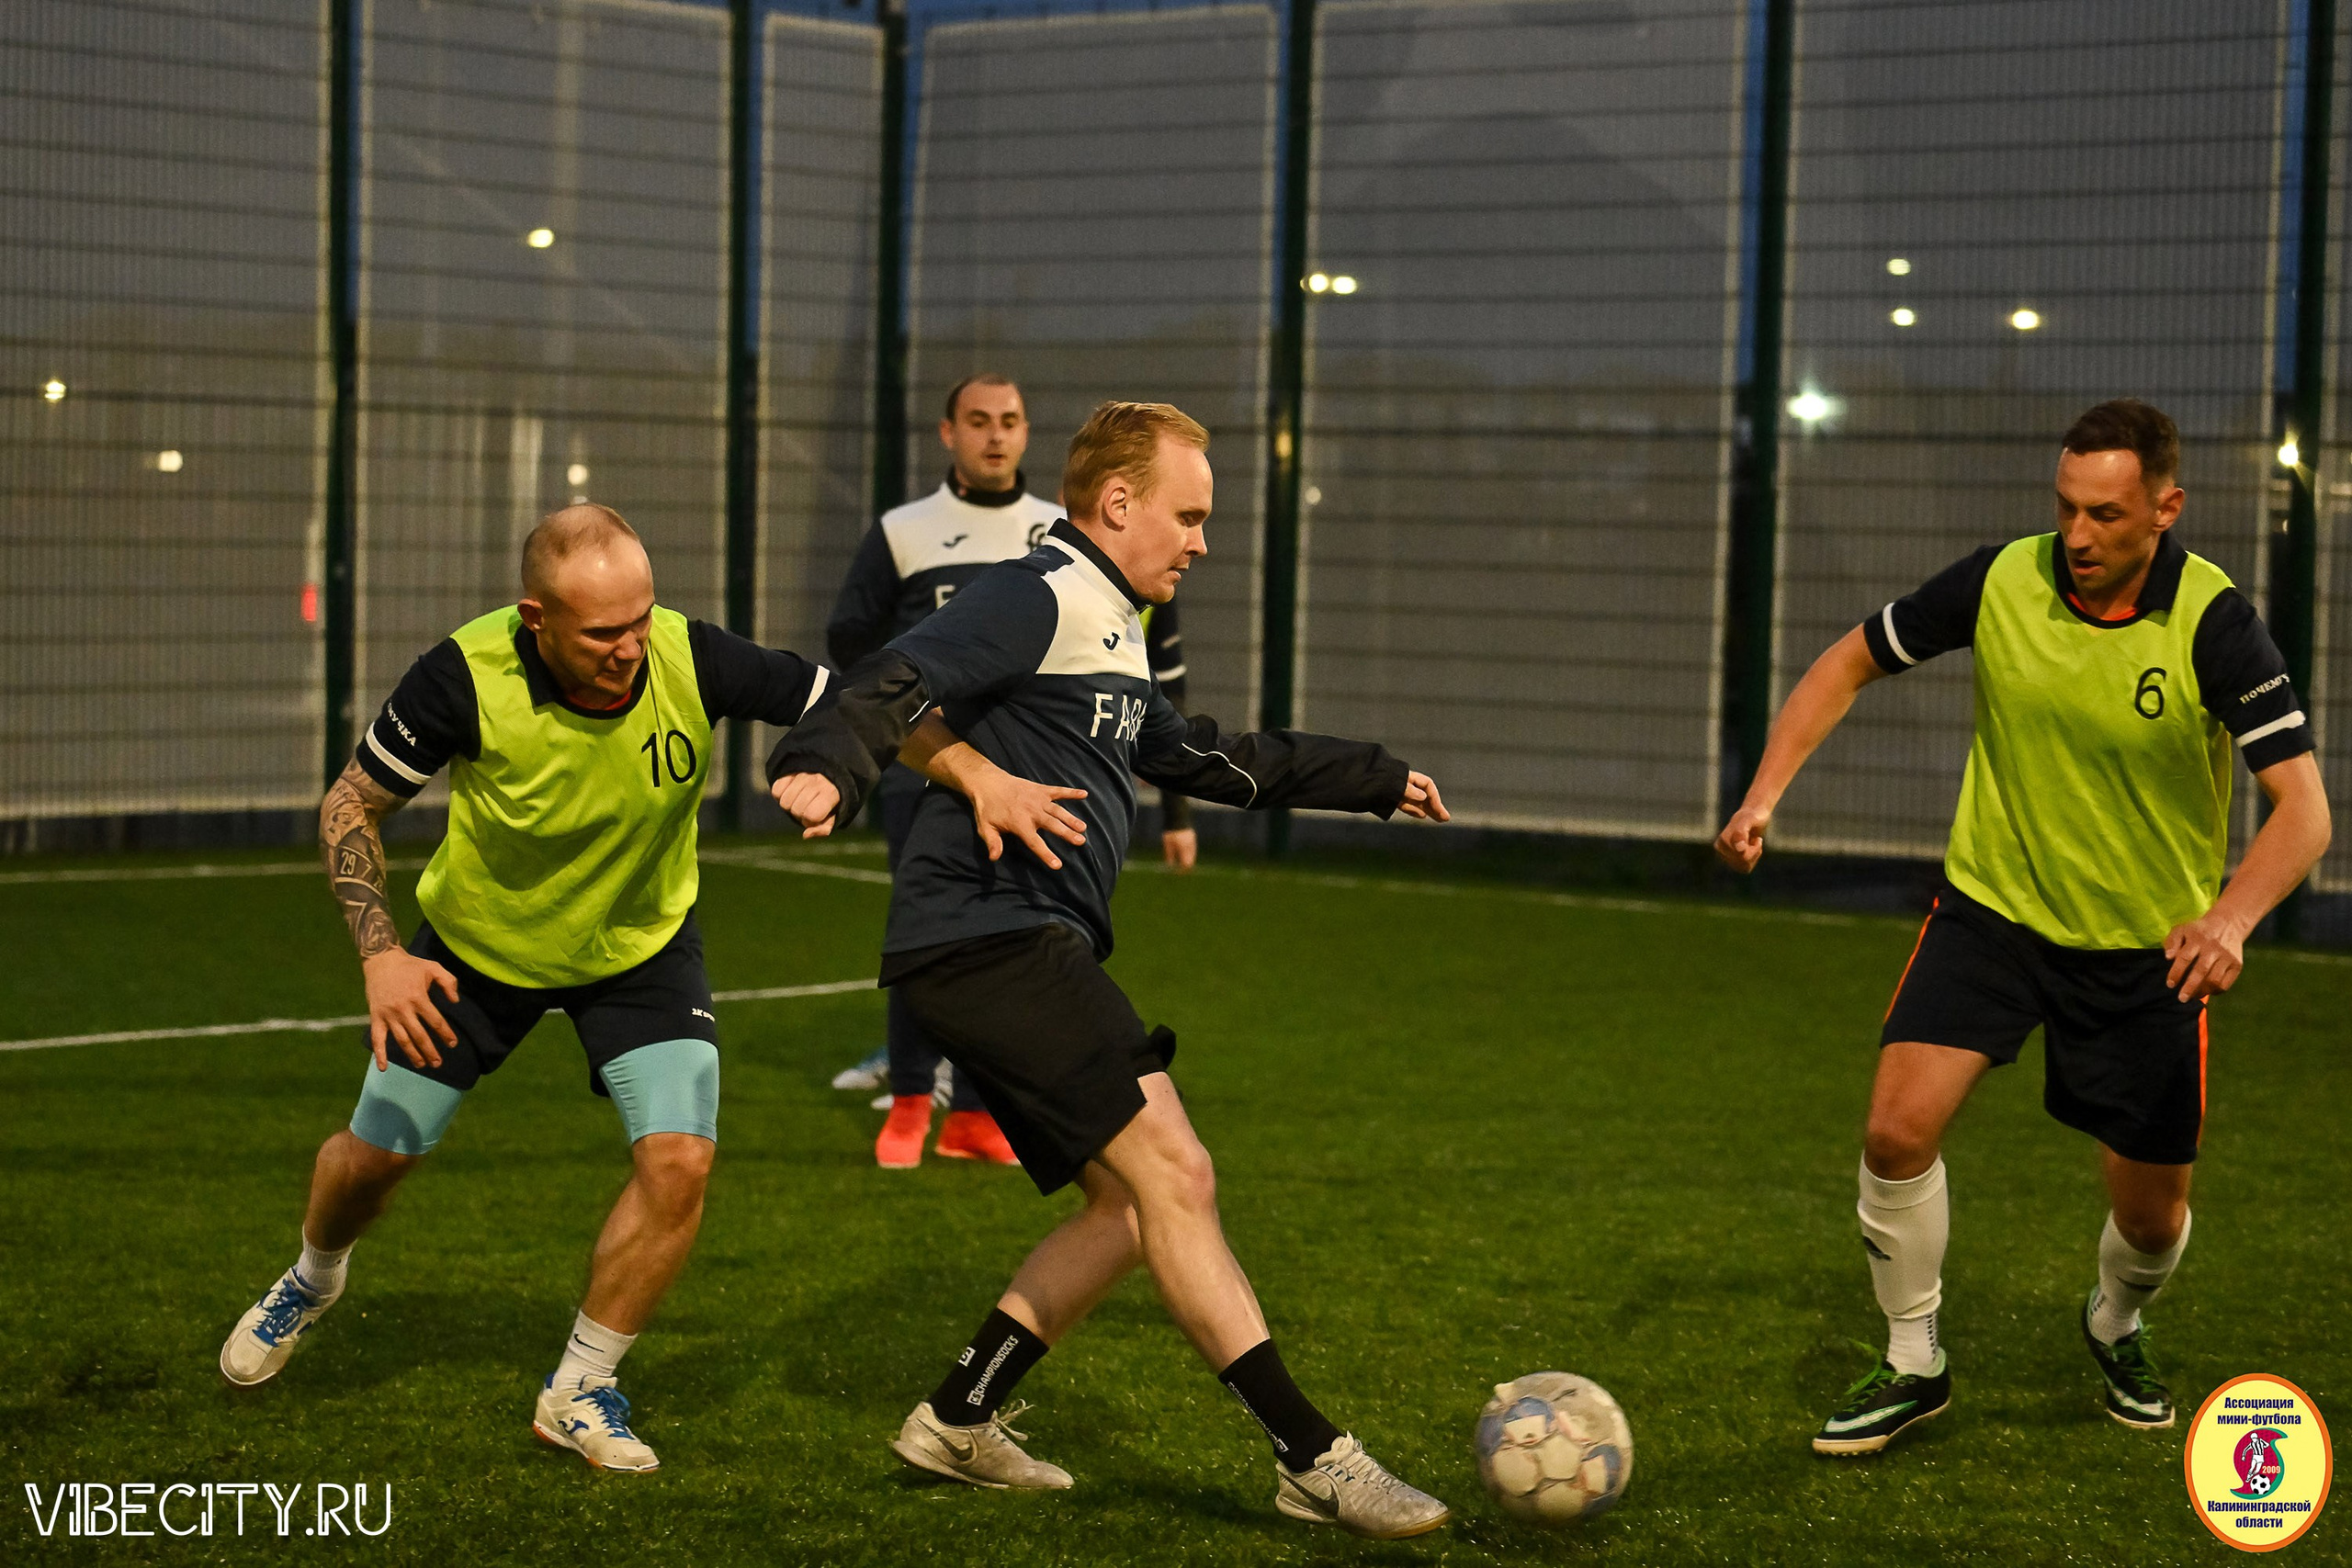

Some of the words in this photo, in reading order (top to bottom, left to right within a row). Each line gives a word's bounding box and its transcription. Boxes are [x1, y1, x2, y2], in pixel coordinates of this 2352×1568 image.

[2135, 667, 2166, 719] 6
[641, 729, 696, 787] 10
[340, 851, 357, 875] 29
[974, 1335, 1019, 1394] CHAMPIONSOCKS
